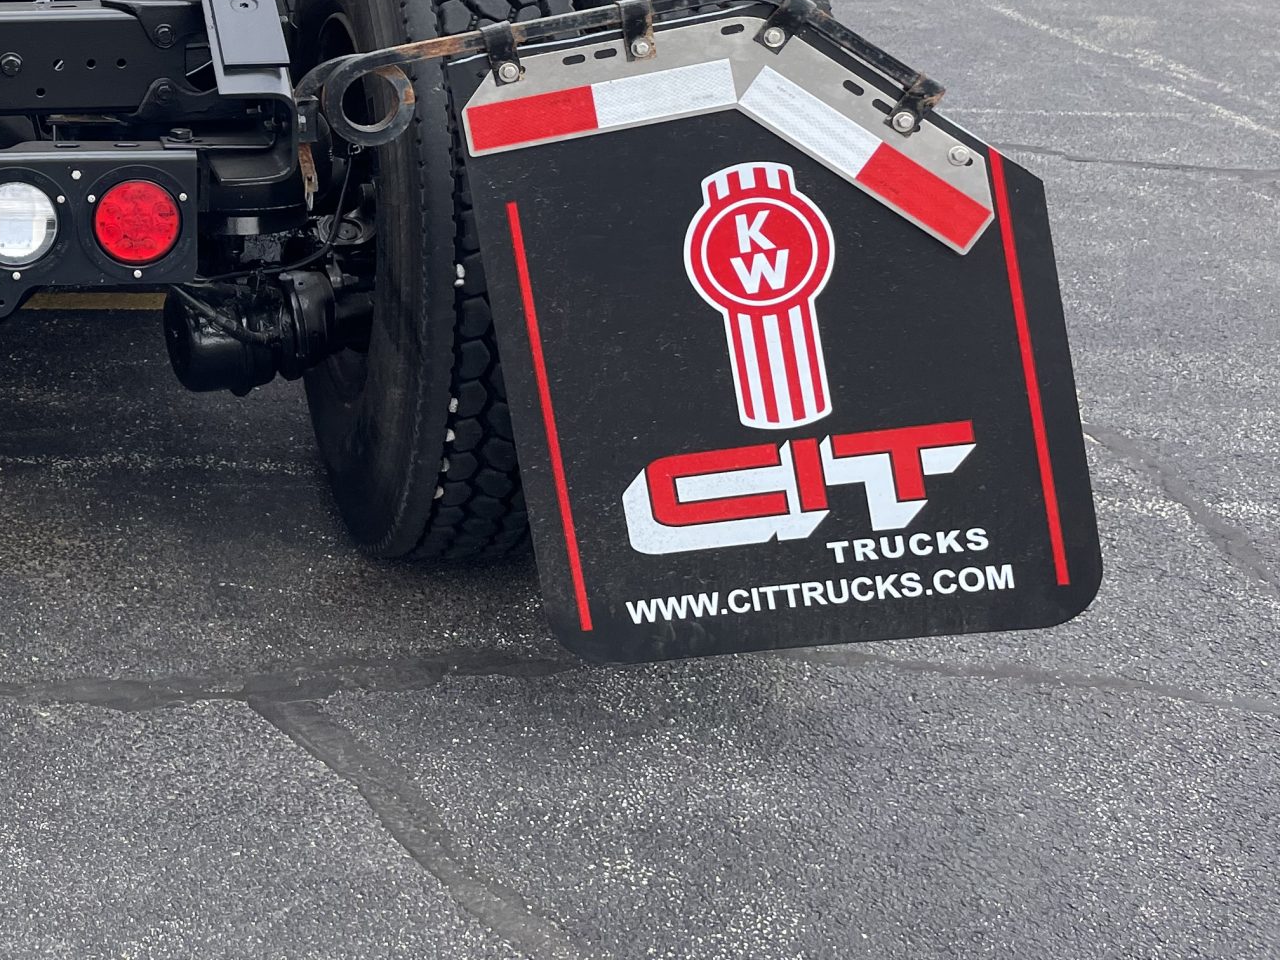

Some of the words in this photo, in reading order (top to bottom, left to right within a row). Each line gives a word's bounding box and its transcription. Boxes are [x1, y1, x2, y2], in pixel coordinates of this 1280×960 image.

[735, 210, 777, 252] K
[729, 249, 790, 294] W
[622, 420, 977, 555] CIT
[826, 527, 990, 564] TRUCKS
[625, 564, 1015, 625] WWW.CITTRUCKS.COM
